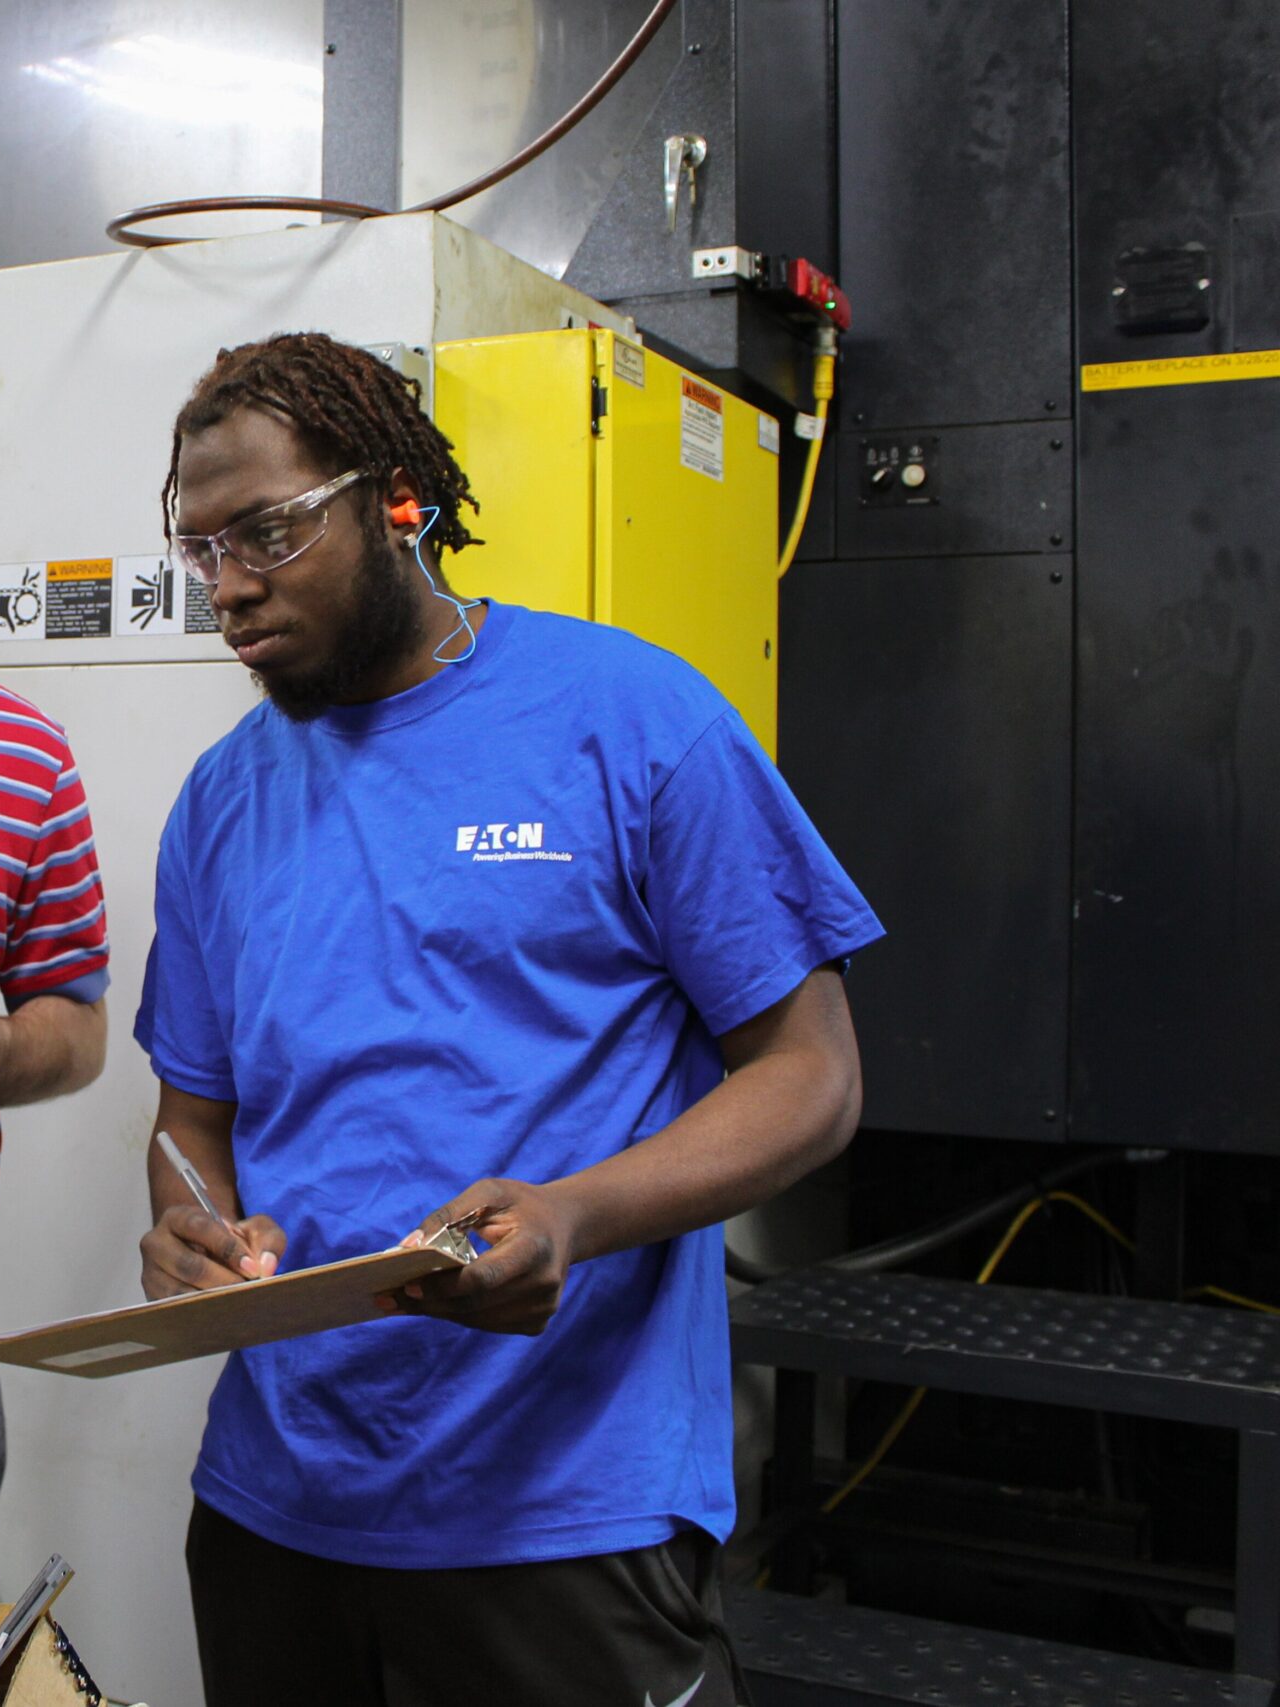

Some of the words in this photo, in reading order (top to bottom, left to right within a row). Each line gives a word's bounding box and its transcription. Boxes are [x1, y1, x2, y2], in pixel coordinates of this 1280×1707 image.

[1086, 363, 1142, 377] BATTERY
[1147, 357, 1208, 371] REPLACE
[1211, 356, 1232, 368] ON
[61, 562, 112, 575] WARNING
[456, 823, 543, 851] EATON
[473, 852, 505, 862] Powering
[505, 851, 536, 860] Business
[535, 851, 572, 861] Worldwide
